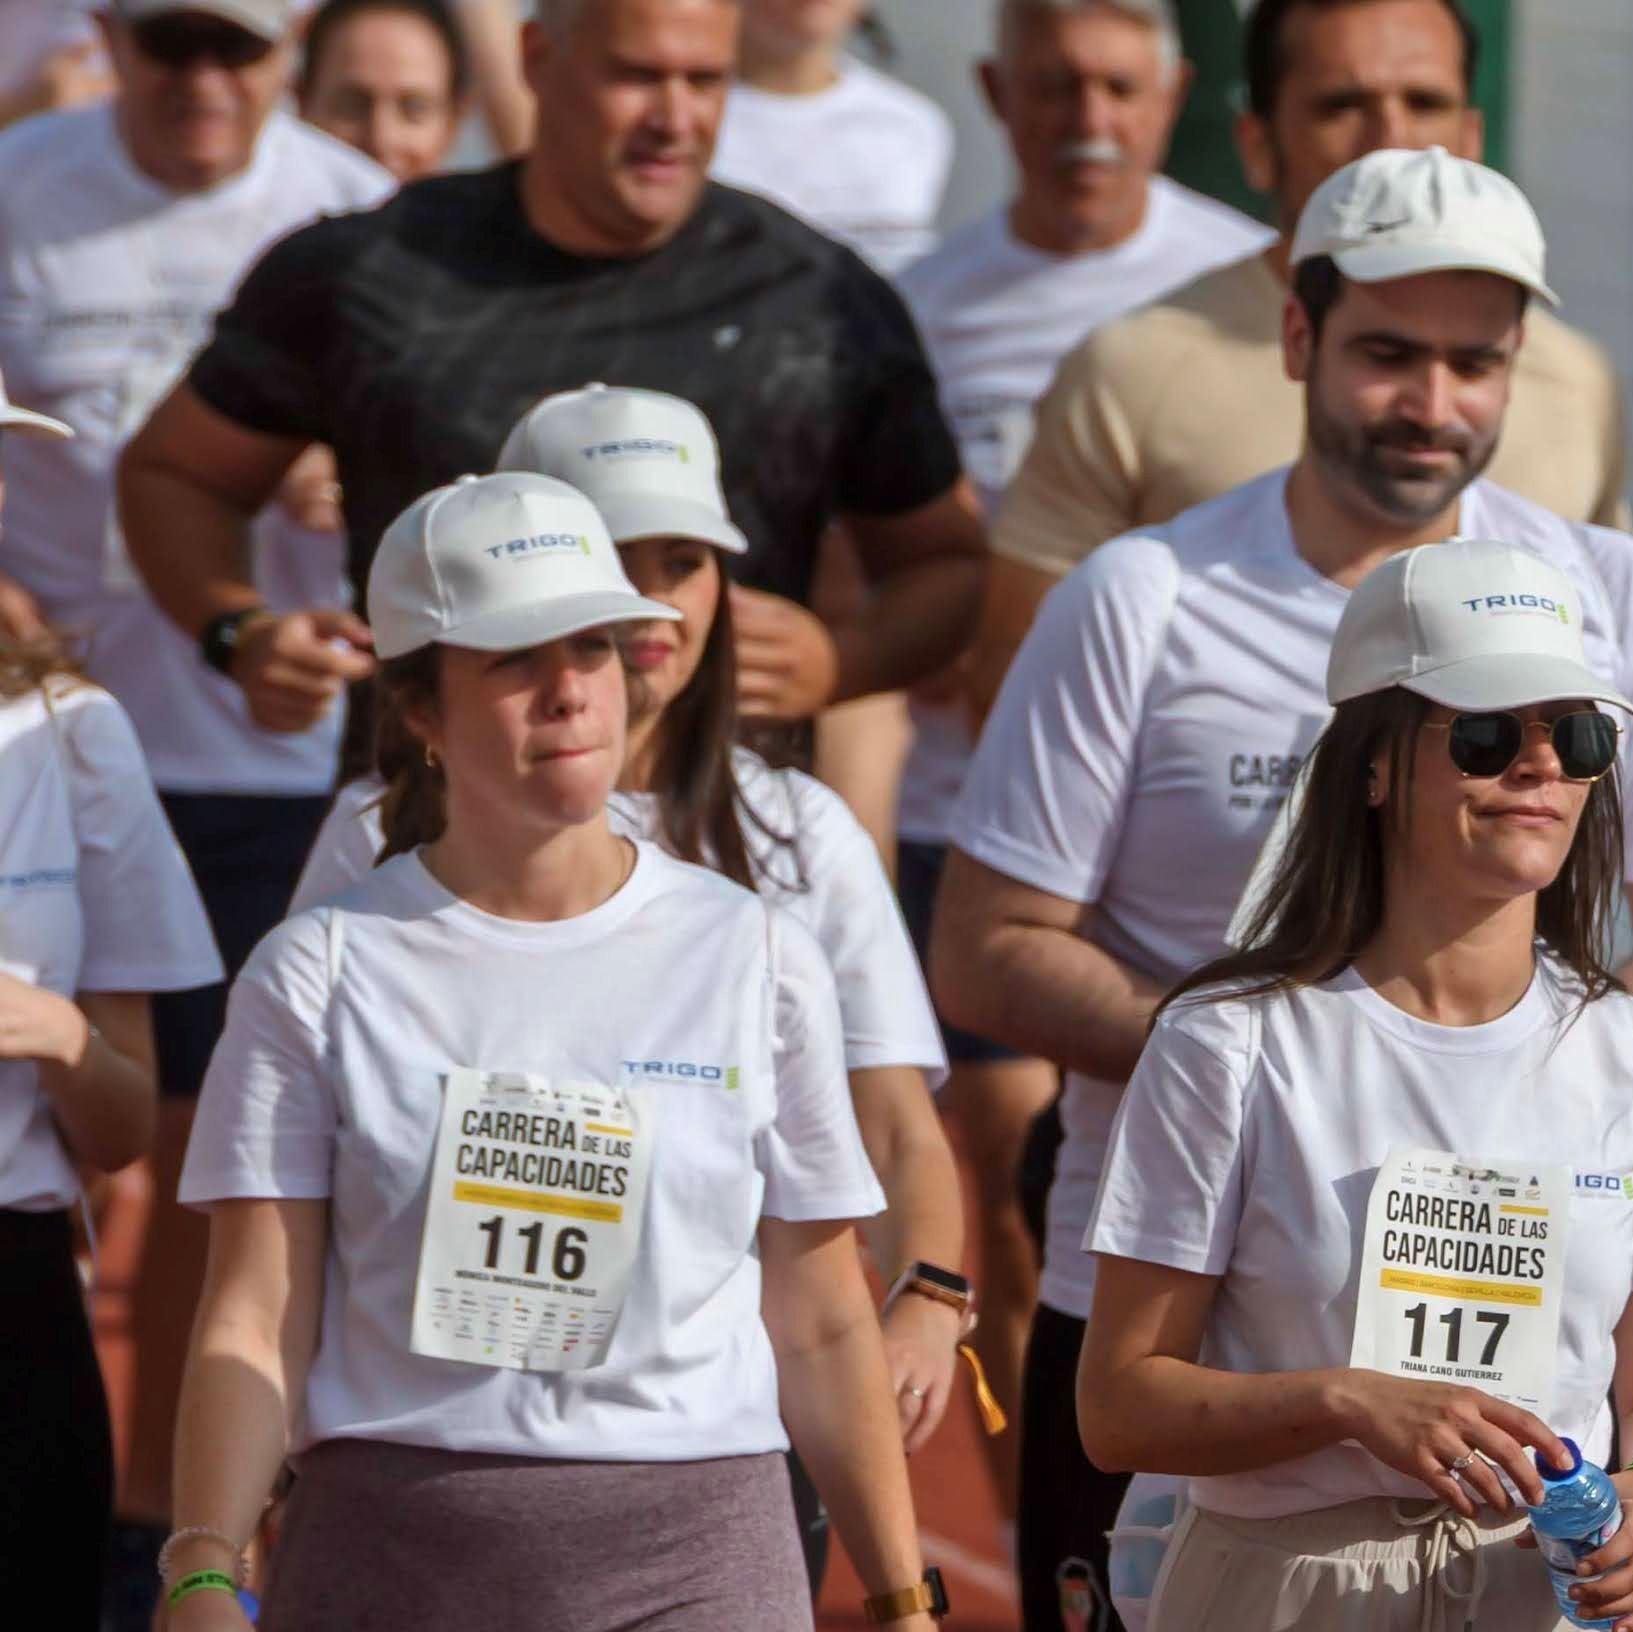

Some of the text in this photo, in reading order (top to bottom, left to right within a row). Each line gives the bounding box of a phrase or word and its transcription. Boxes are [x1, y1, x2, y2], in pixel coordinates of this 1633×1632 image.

[486, 533, 577, 558] TRIGO
[1462, 594, 1556, 612] TRIGO
[624, 1060, 721, 1080] TRIGO
[462, 1109, 632, 1159] CARRERA DE LAS
[456, 1144, 629, 1197] CAPACIDADES
[1386, 1189, 1548, 1240] CARRERA DE LAS
[478, 1214, 588, 1282] 116
[1382, 1229, 1546, 1280] CAPACIDADES
[1404, 1302, 1510, 1366] 117
[1400, 1360, 1503, 1382] TRIANA CANO GUTIERREZ
